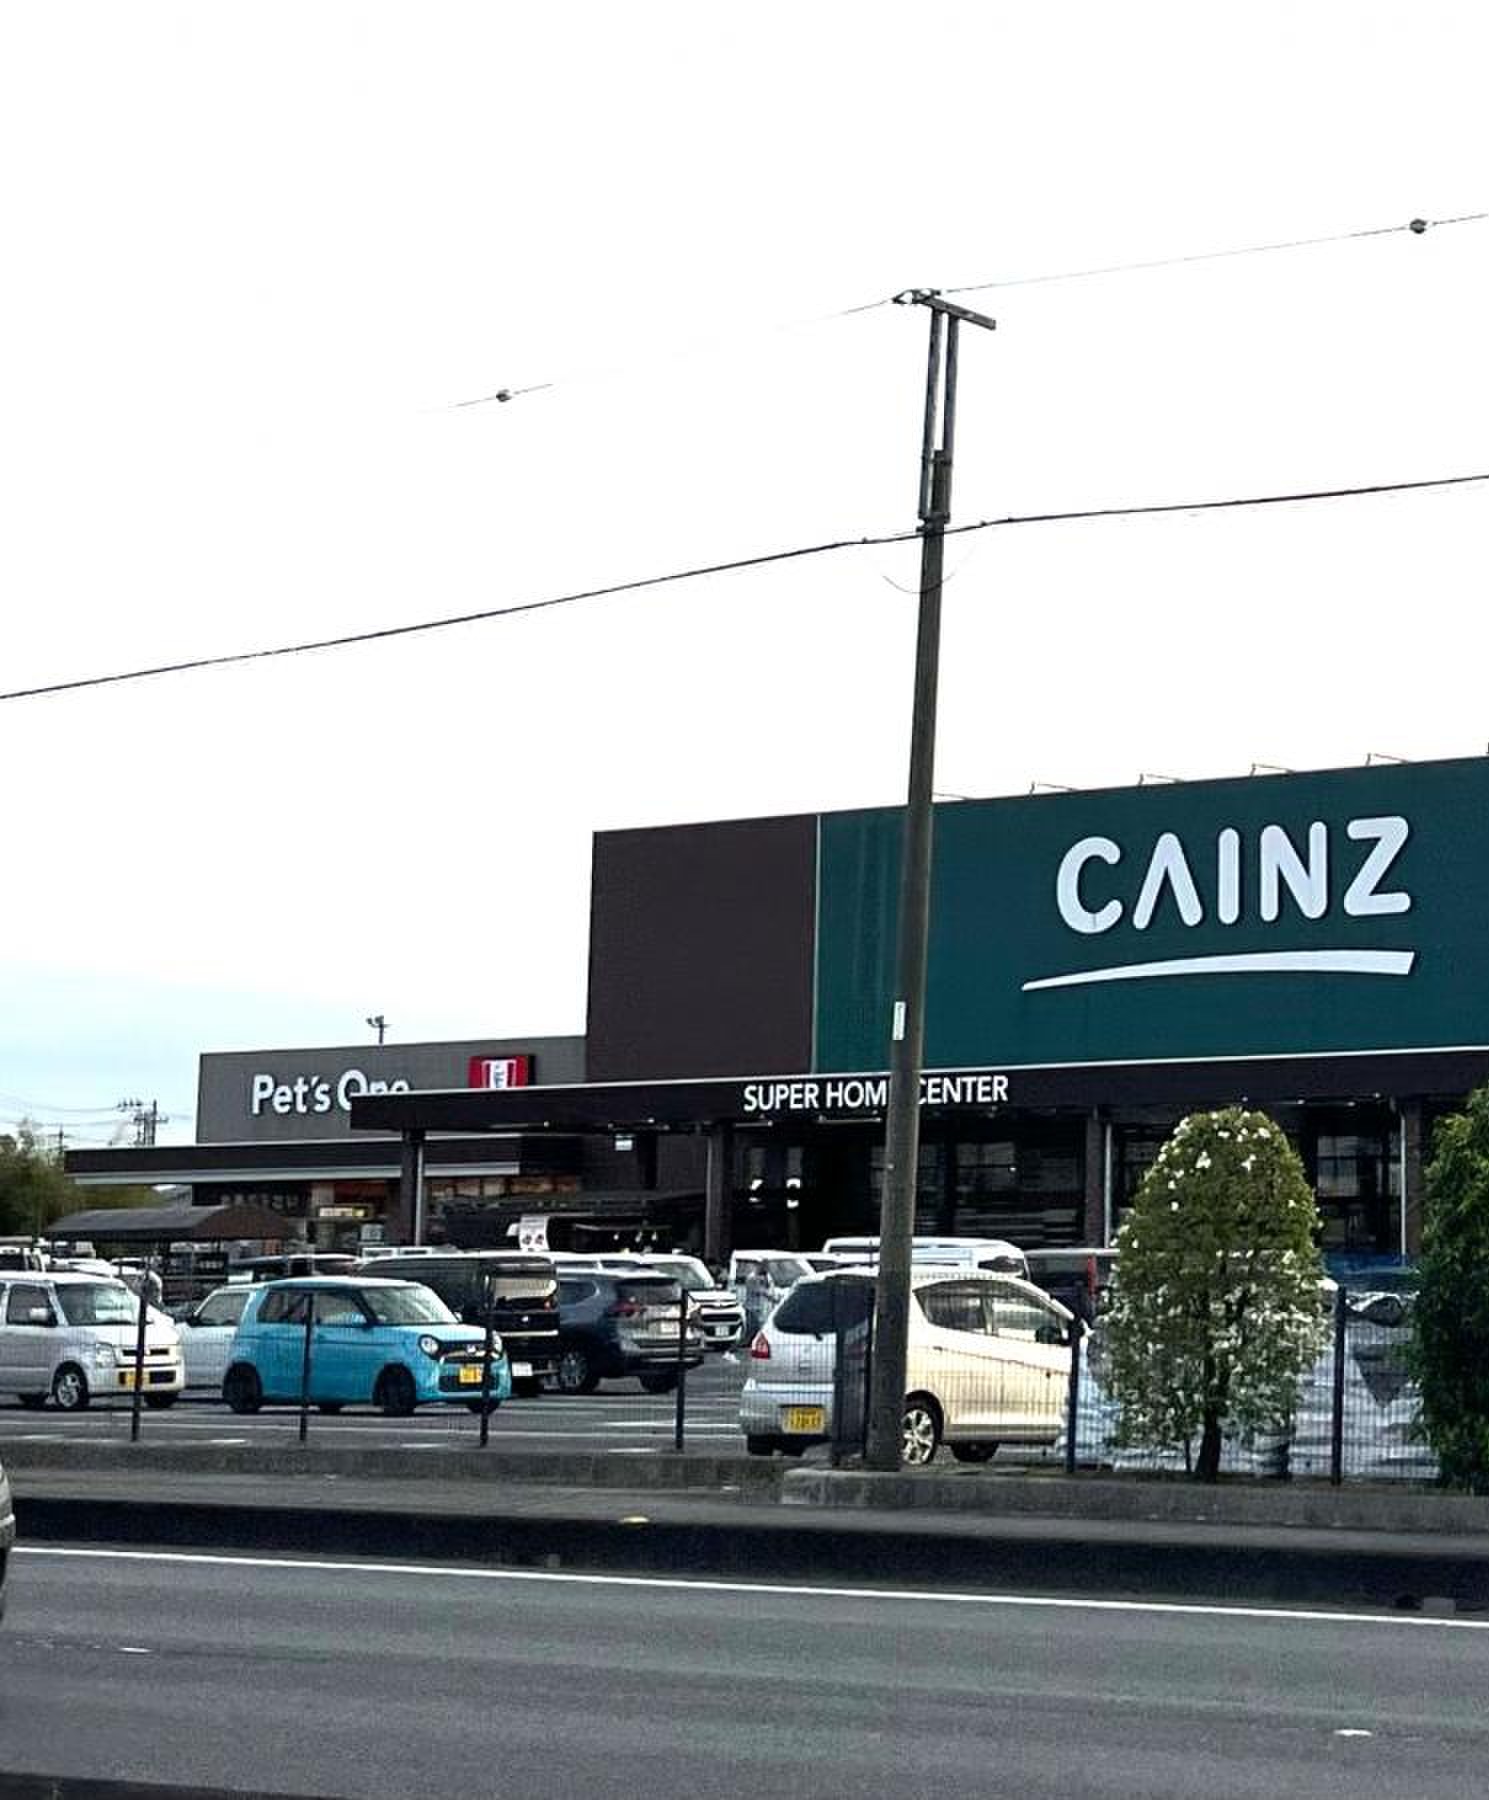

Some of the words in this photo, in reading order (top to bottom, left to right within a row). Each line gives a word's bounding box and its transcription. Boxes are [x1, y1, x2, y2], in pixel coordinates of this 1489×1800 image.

[1056, 816, 1412, 934] CAINZ
[252, 1074, 332, 1115] Pet's
[743, 1082, 819, 1111] SUPER
[826, 1080, 888, 1108] HOM
